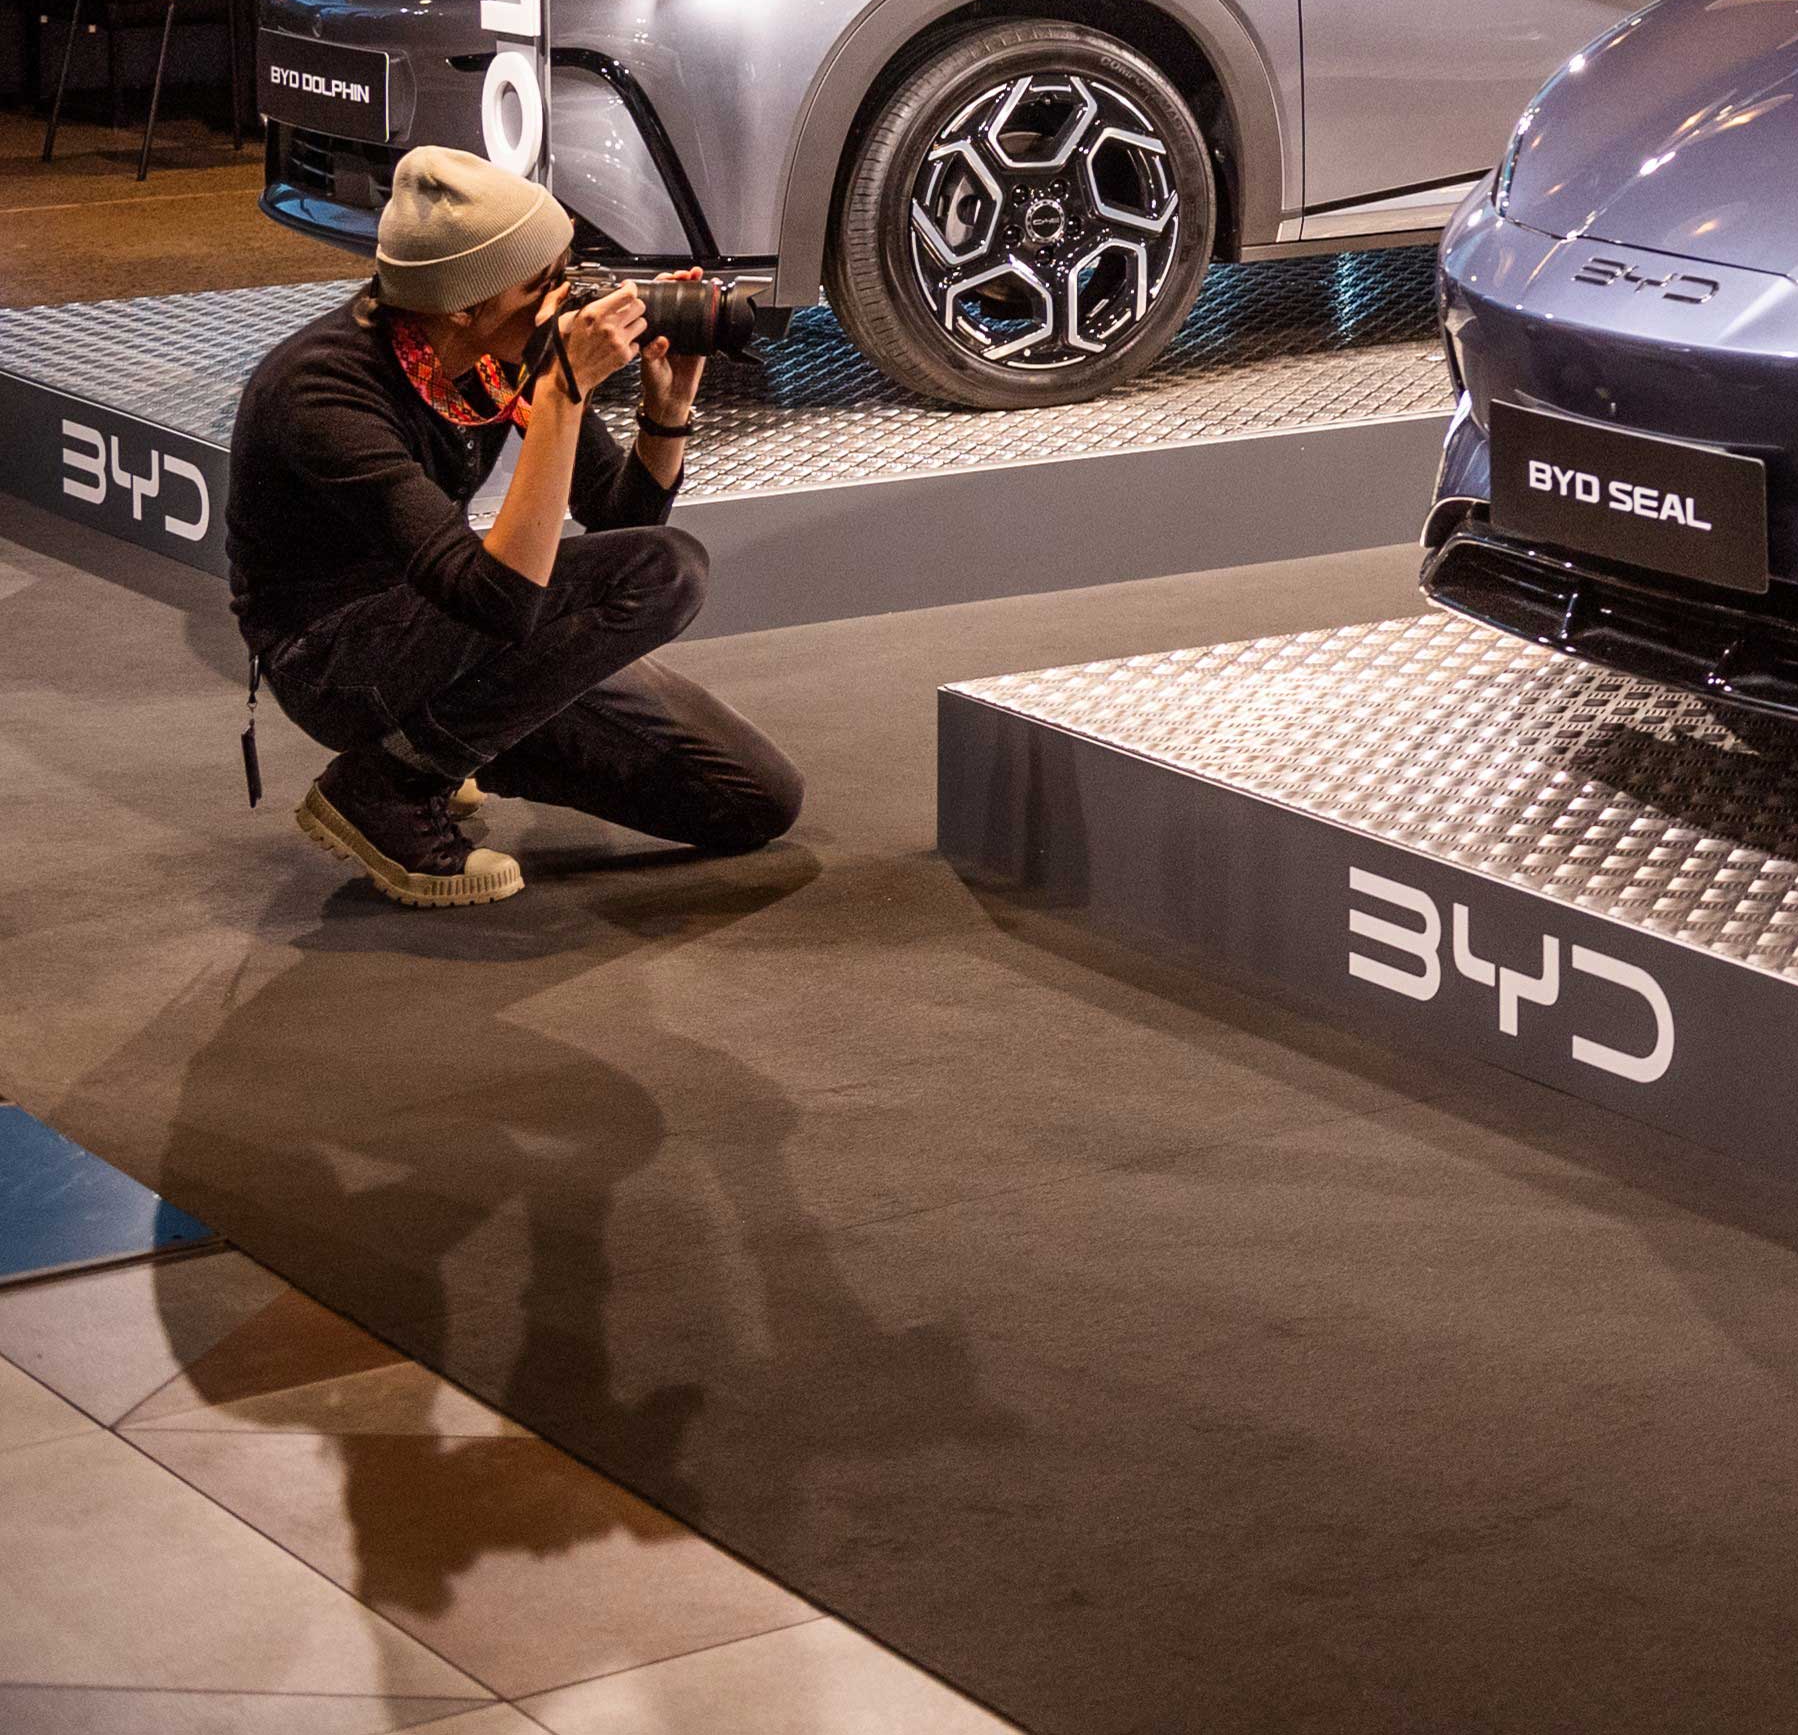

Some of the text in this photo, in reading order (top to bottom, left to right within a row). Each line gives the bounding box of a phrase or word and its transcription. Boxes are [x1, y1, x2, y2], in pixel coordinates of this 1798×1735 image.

[270, 65, 370, 104] BYD DOLPHIN
[1570, 257, 1720, 305] BYD
[62, 418, 210, 542] BYD
[1529, 459, 1712, 532] BYD SEAL
[1349, 865, 1675, 1084] BYD
